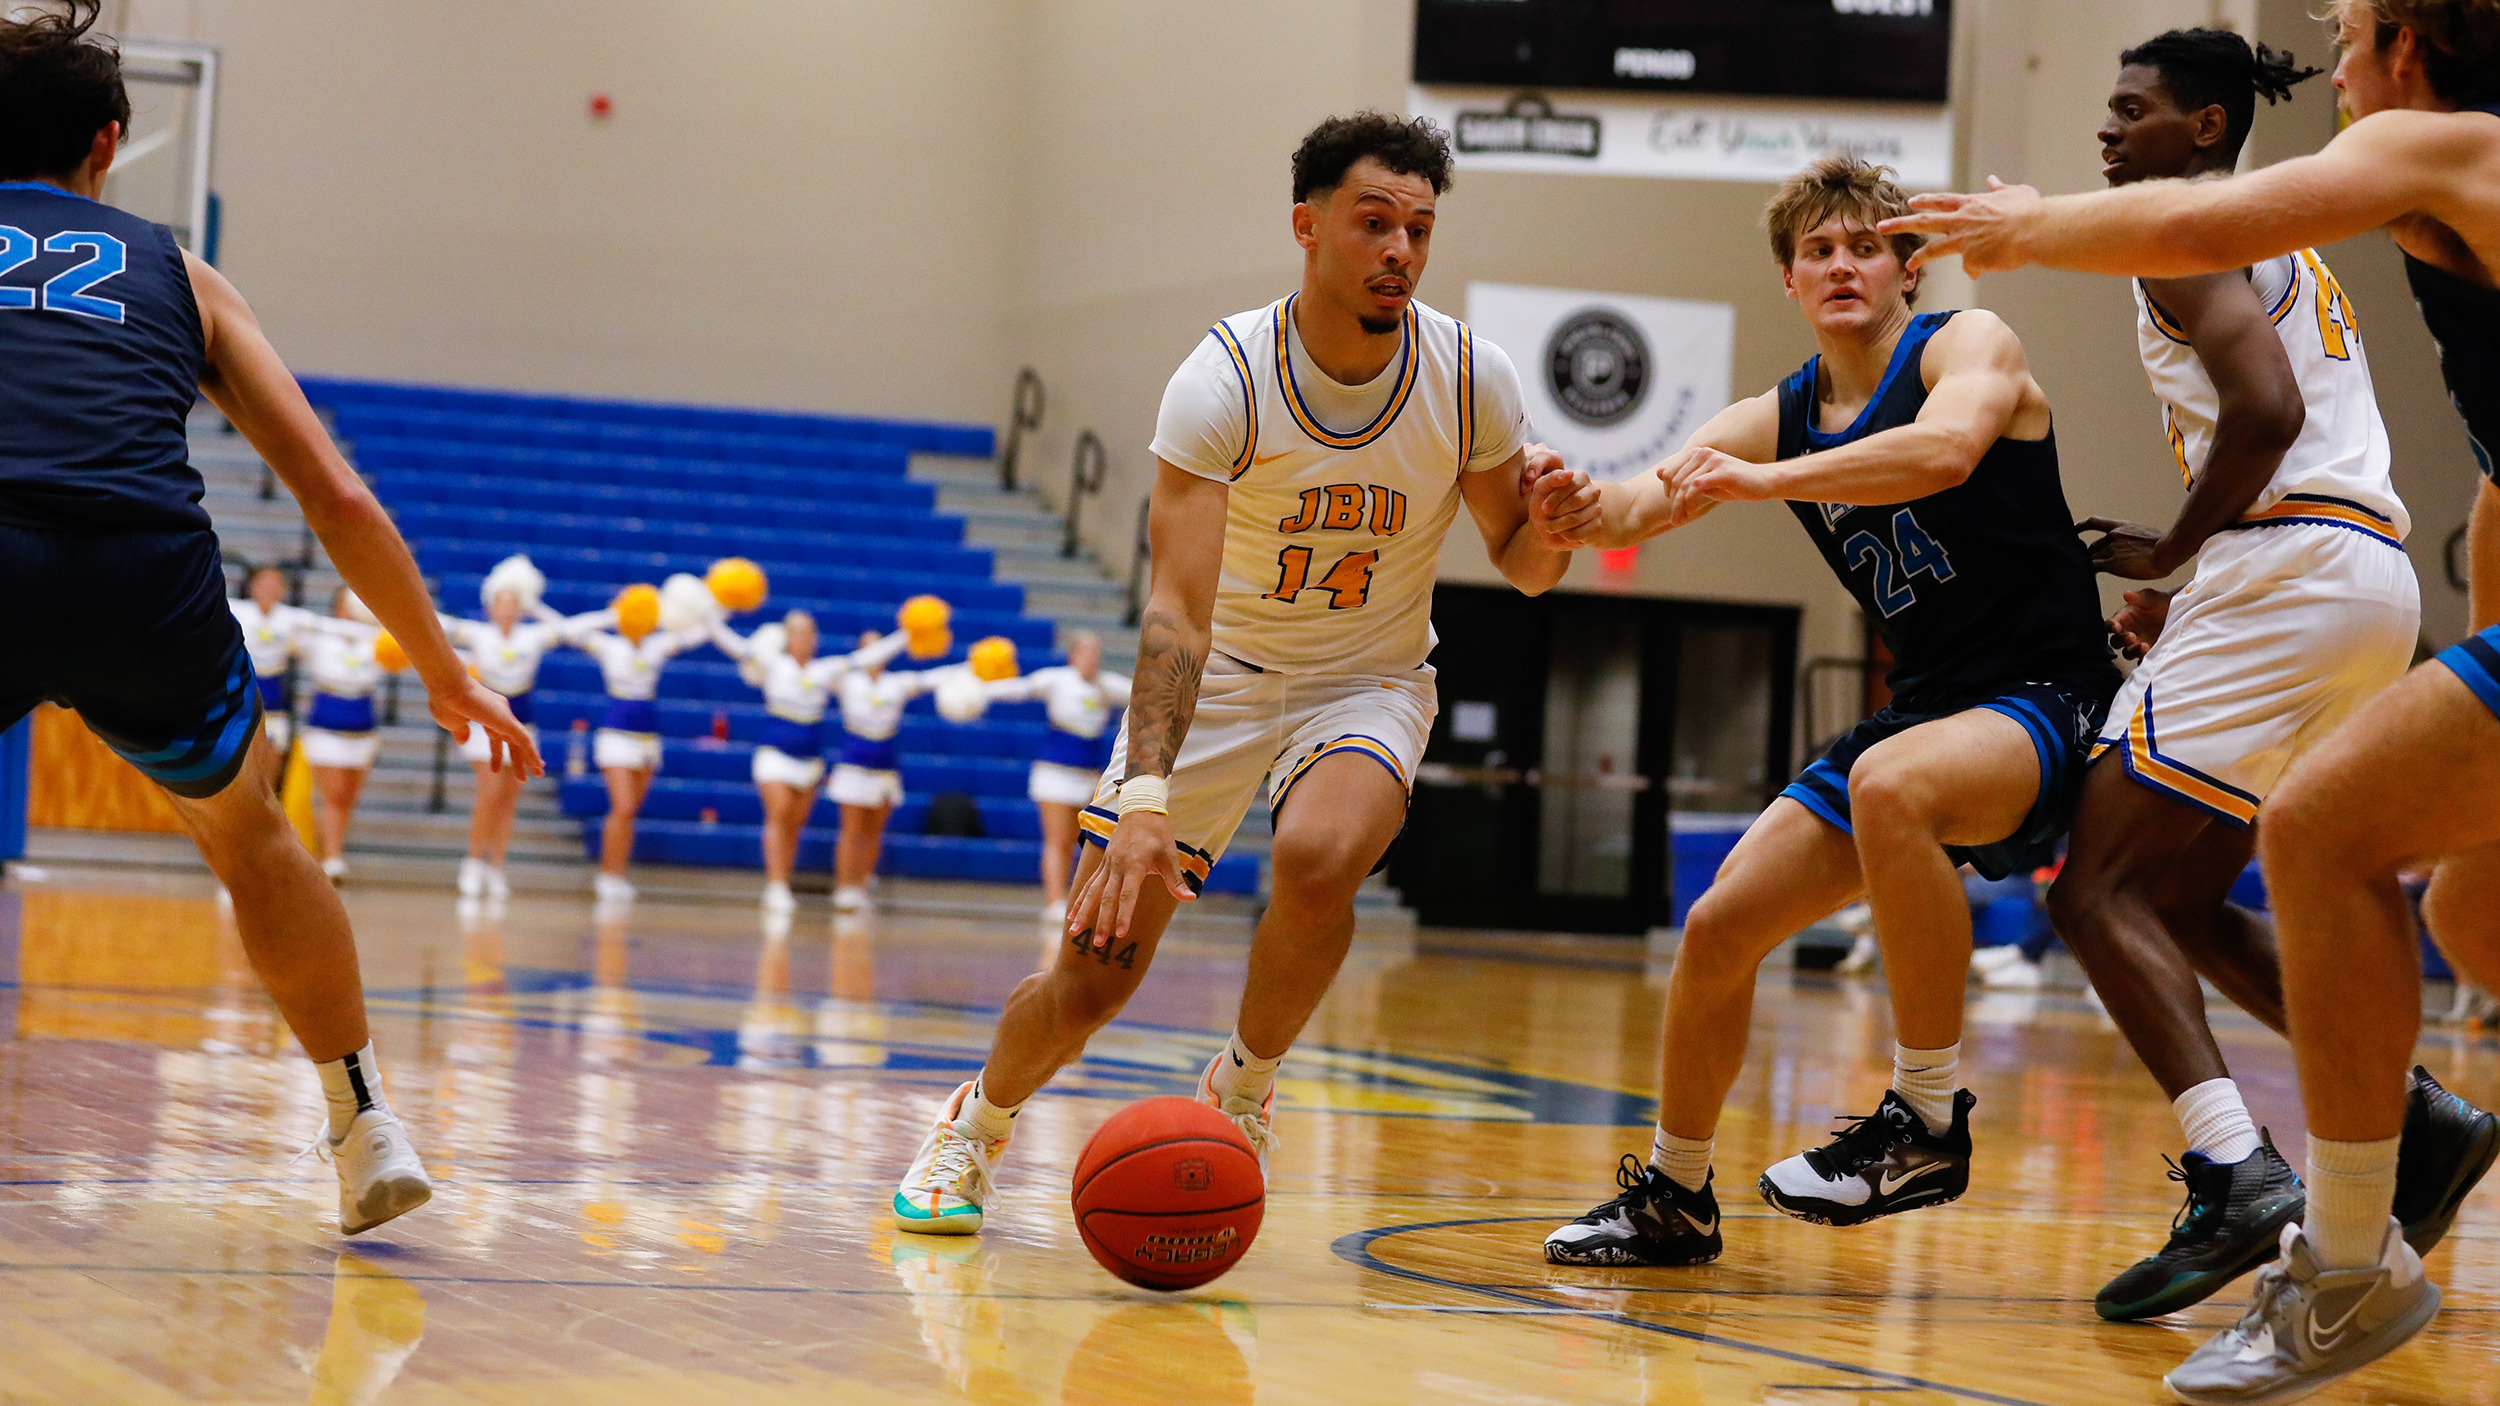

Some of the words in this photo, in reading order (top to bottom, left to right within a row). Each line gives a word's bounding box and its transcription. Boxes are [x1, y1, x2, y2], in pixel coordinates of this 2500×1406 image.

[1278, 483, 1407, 536] JBU
[1261, 545, 1379, 609] 14
[1843, 507, 1957, 619] 24
[1071, 928, 1138, 970] 444
